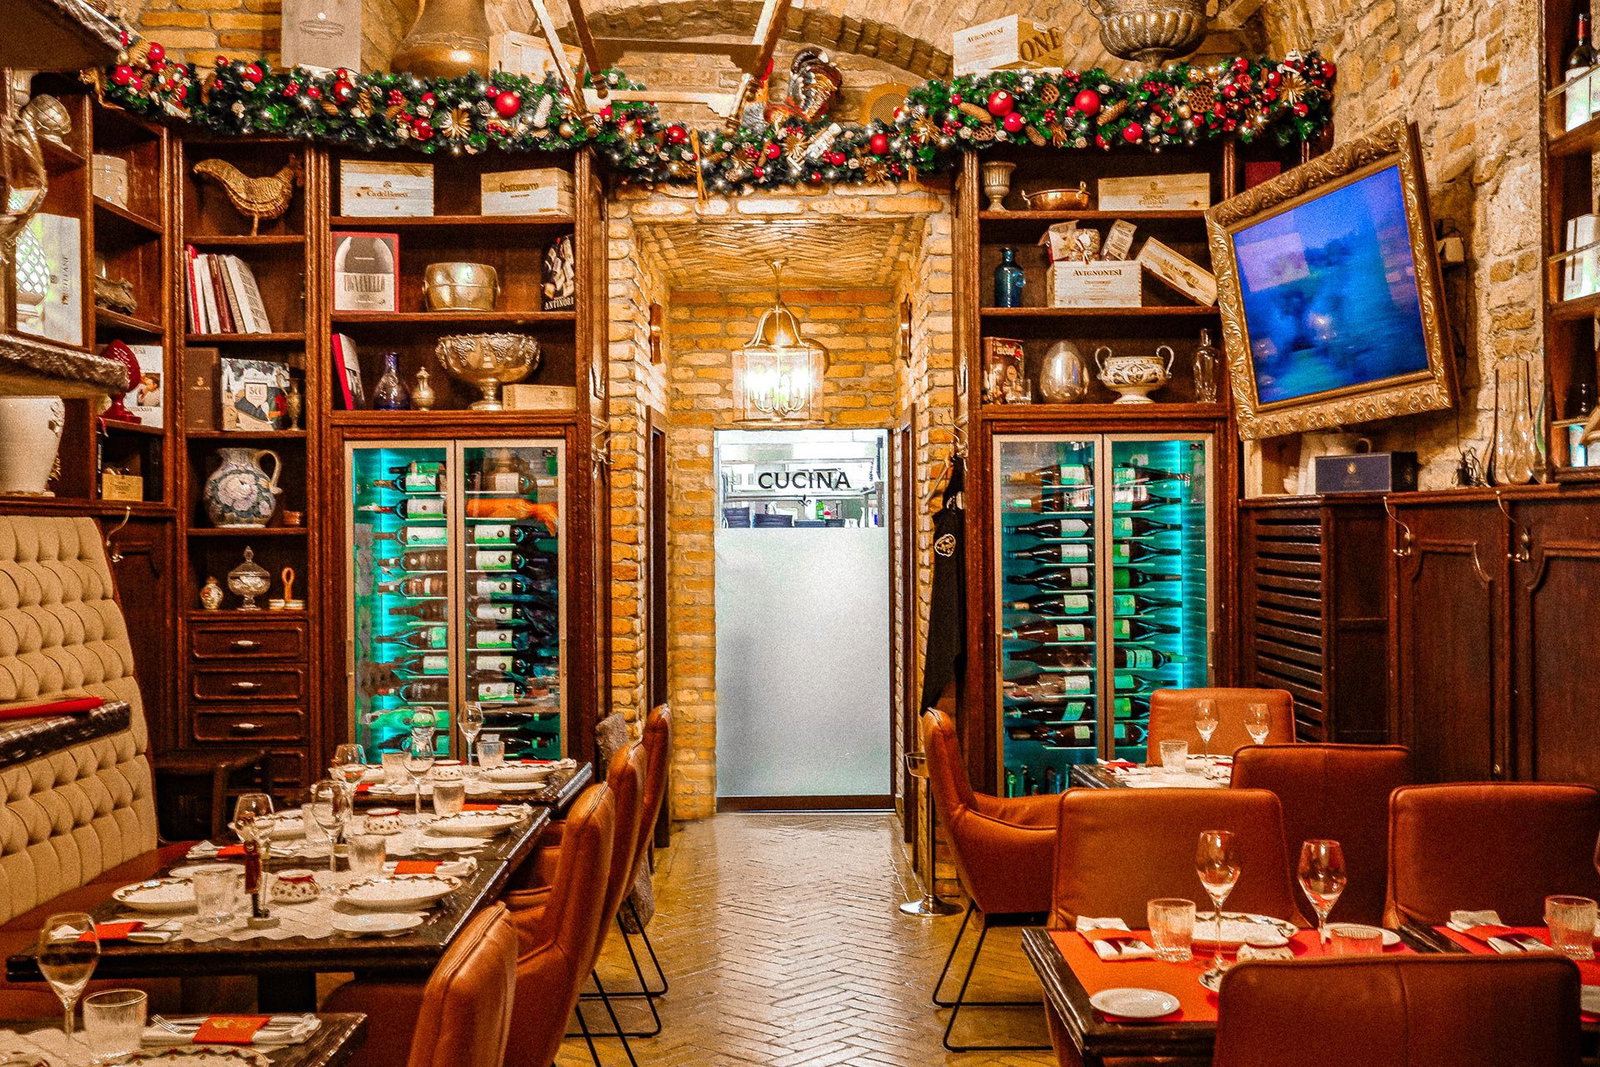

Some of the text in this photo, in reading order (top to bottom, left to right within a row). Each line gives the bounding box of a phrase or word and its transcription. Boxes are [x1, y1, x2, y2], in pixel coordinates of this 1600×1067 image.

[1020, 26, 1062, 62] ONE
[1073, 269, 1122, 277] AVIGNONESI
[758, 471, 852, 489] CUCINA
